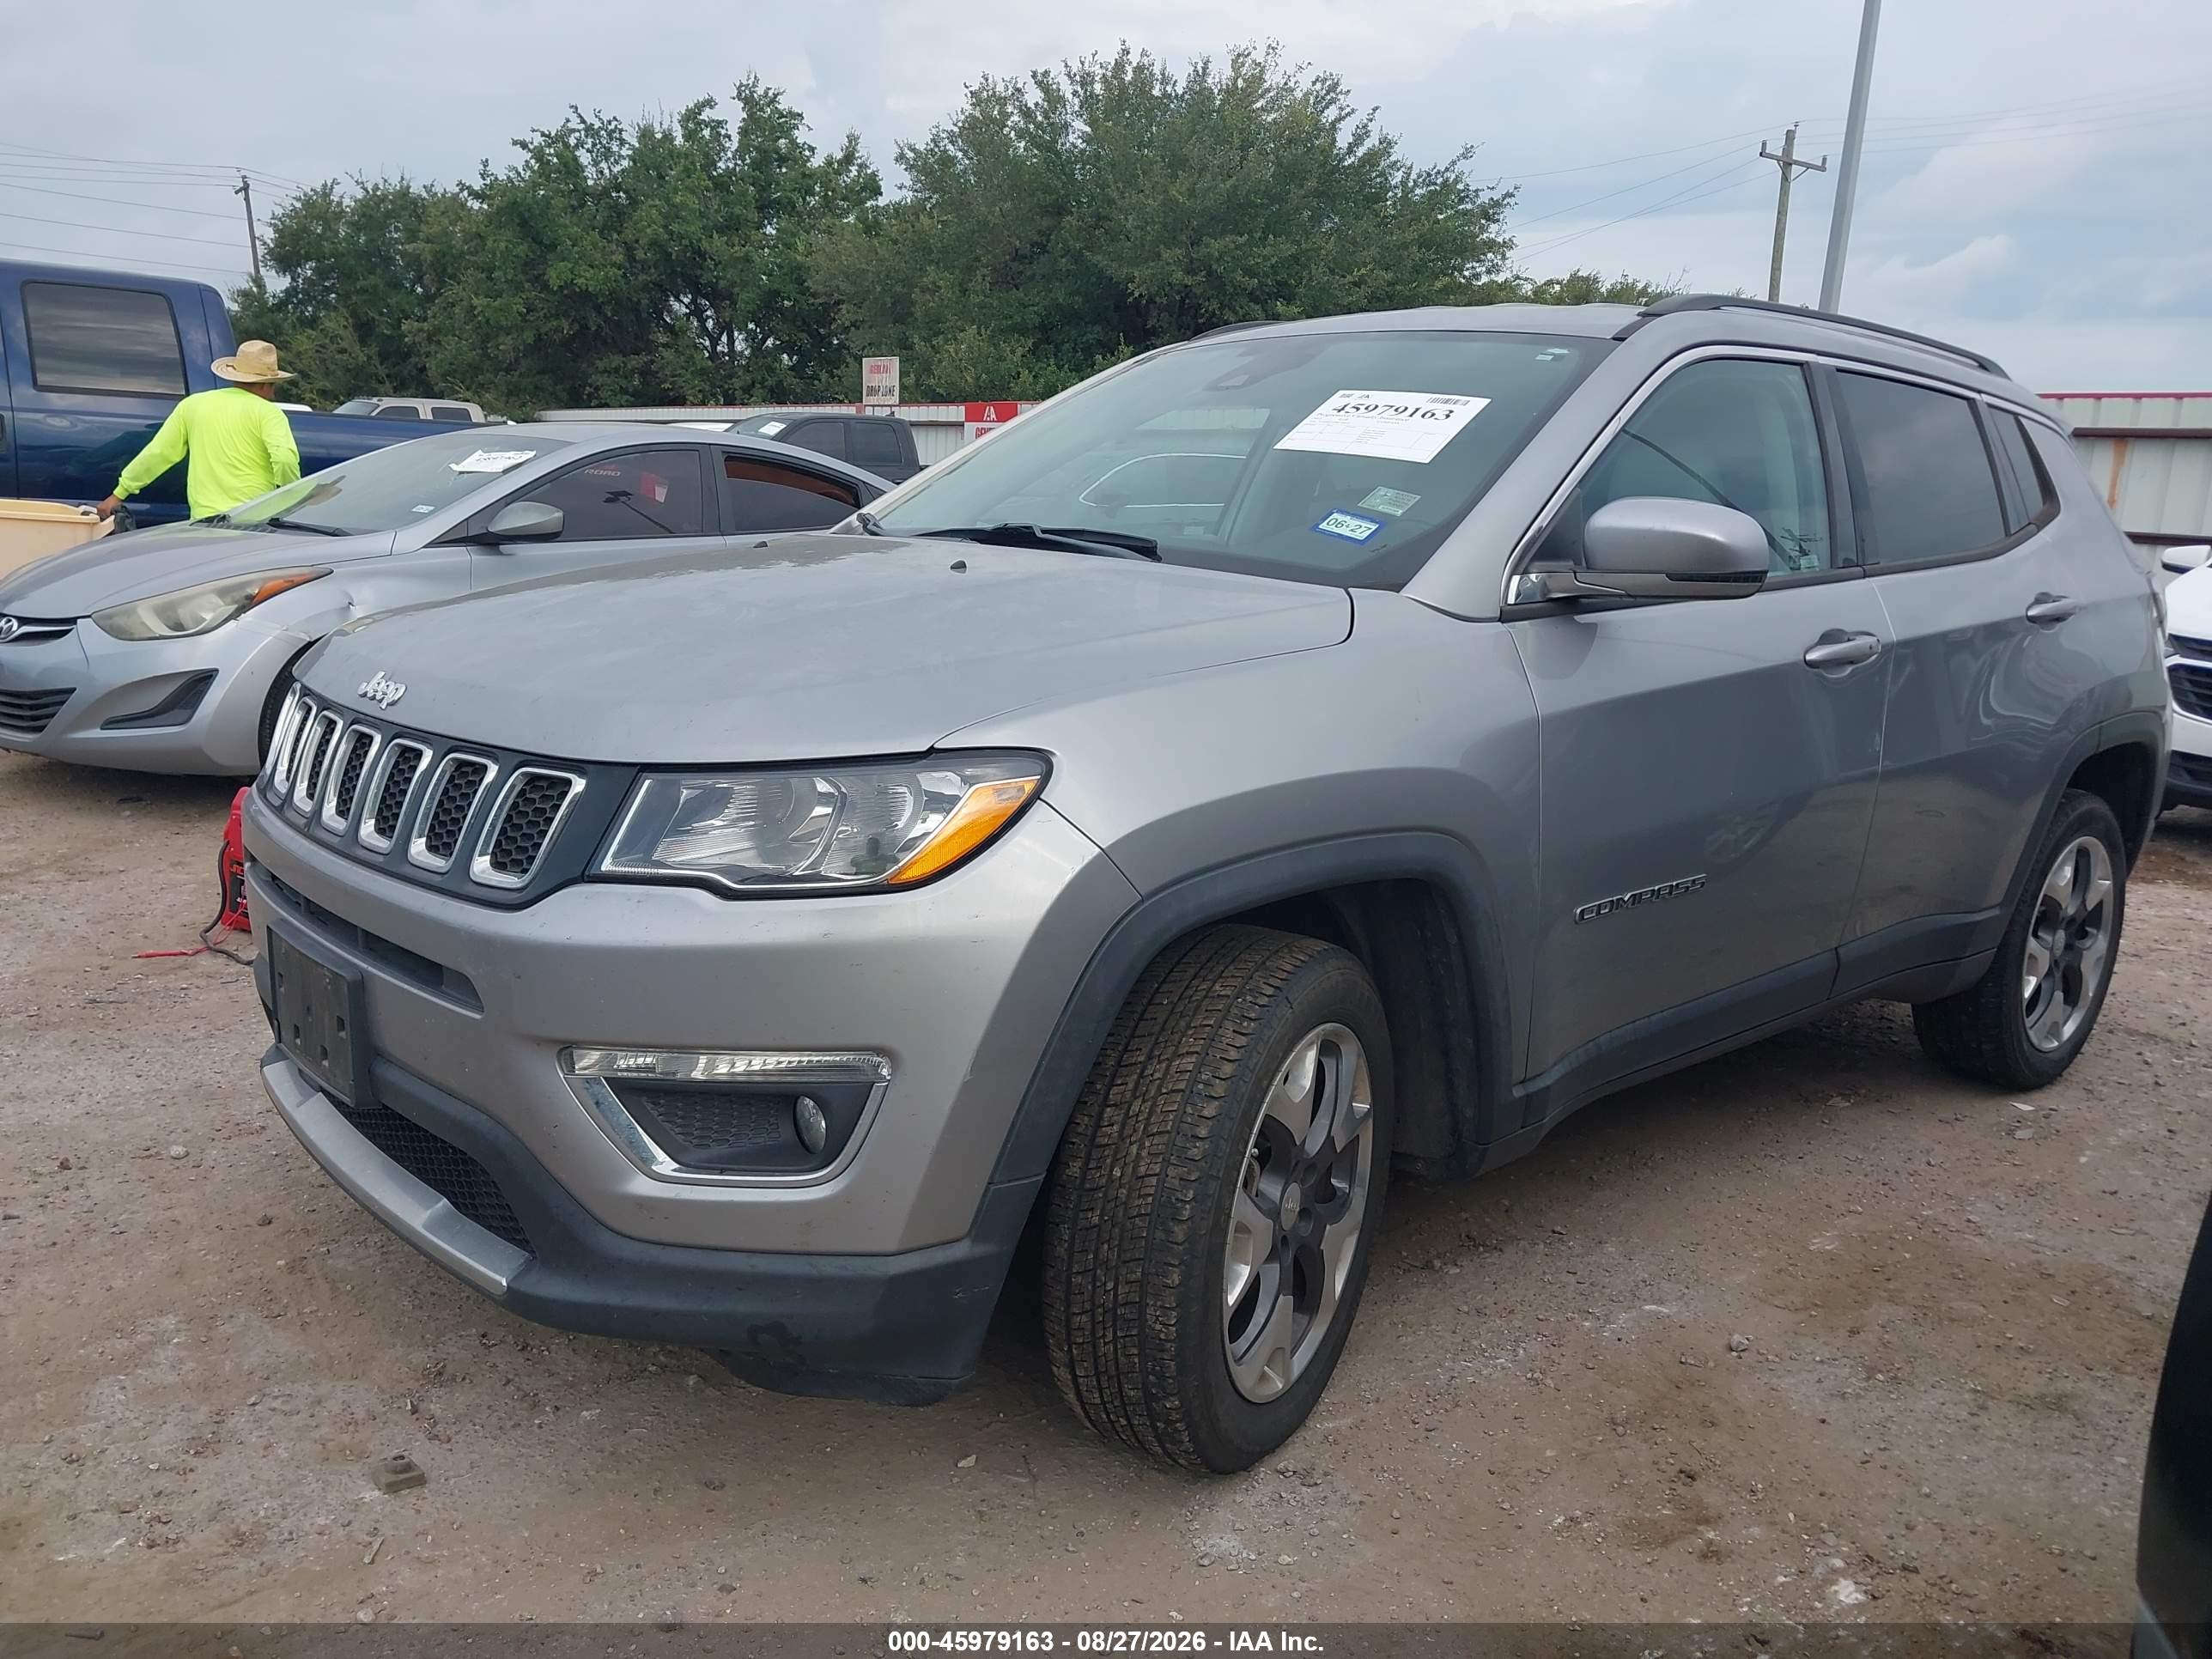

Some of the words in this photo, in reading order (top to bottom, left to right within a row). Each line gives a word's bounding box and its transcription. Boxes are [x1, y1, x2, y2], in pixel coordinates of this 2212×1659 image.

[866, 385, 881, 397] DROP
[1332, 402, 1455, 421] 45979163
[1325, 517, 1346, 529] 06
[1348, 524, 1373, 535] 27
[357, 671, 407, 710] Jeep
[1573, 873, 1707, 924] COMPASS
